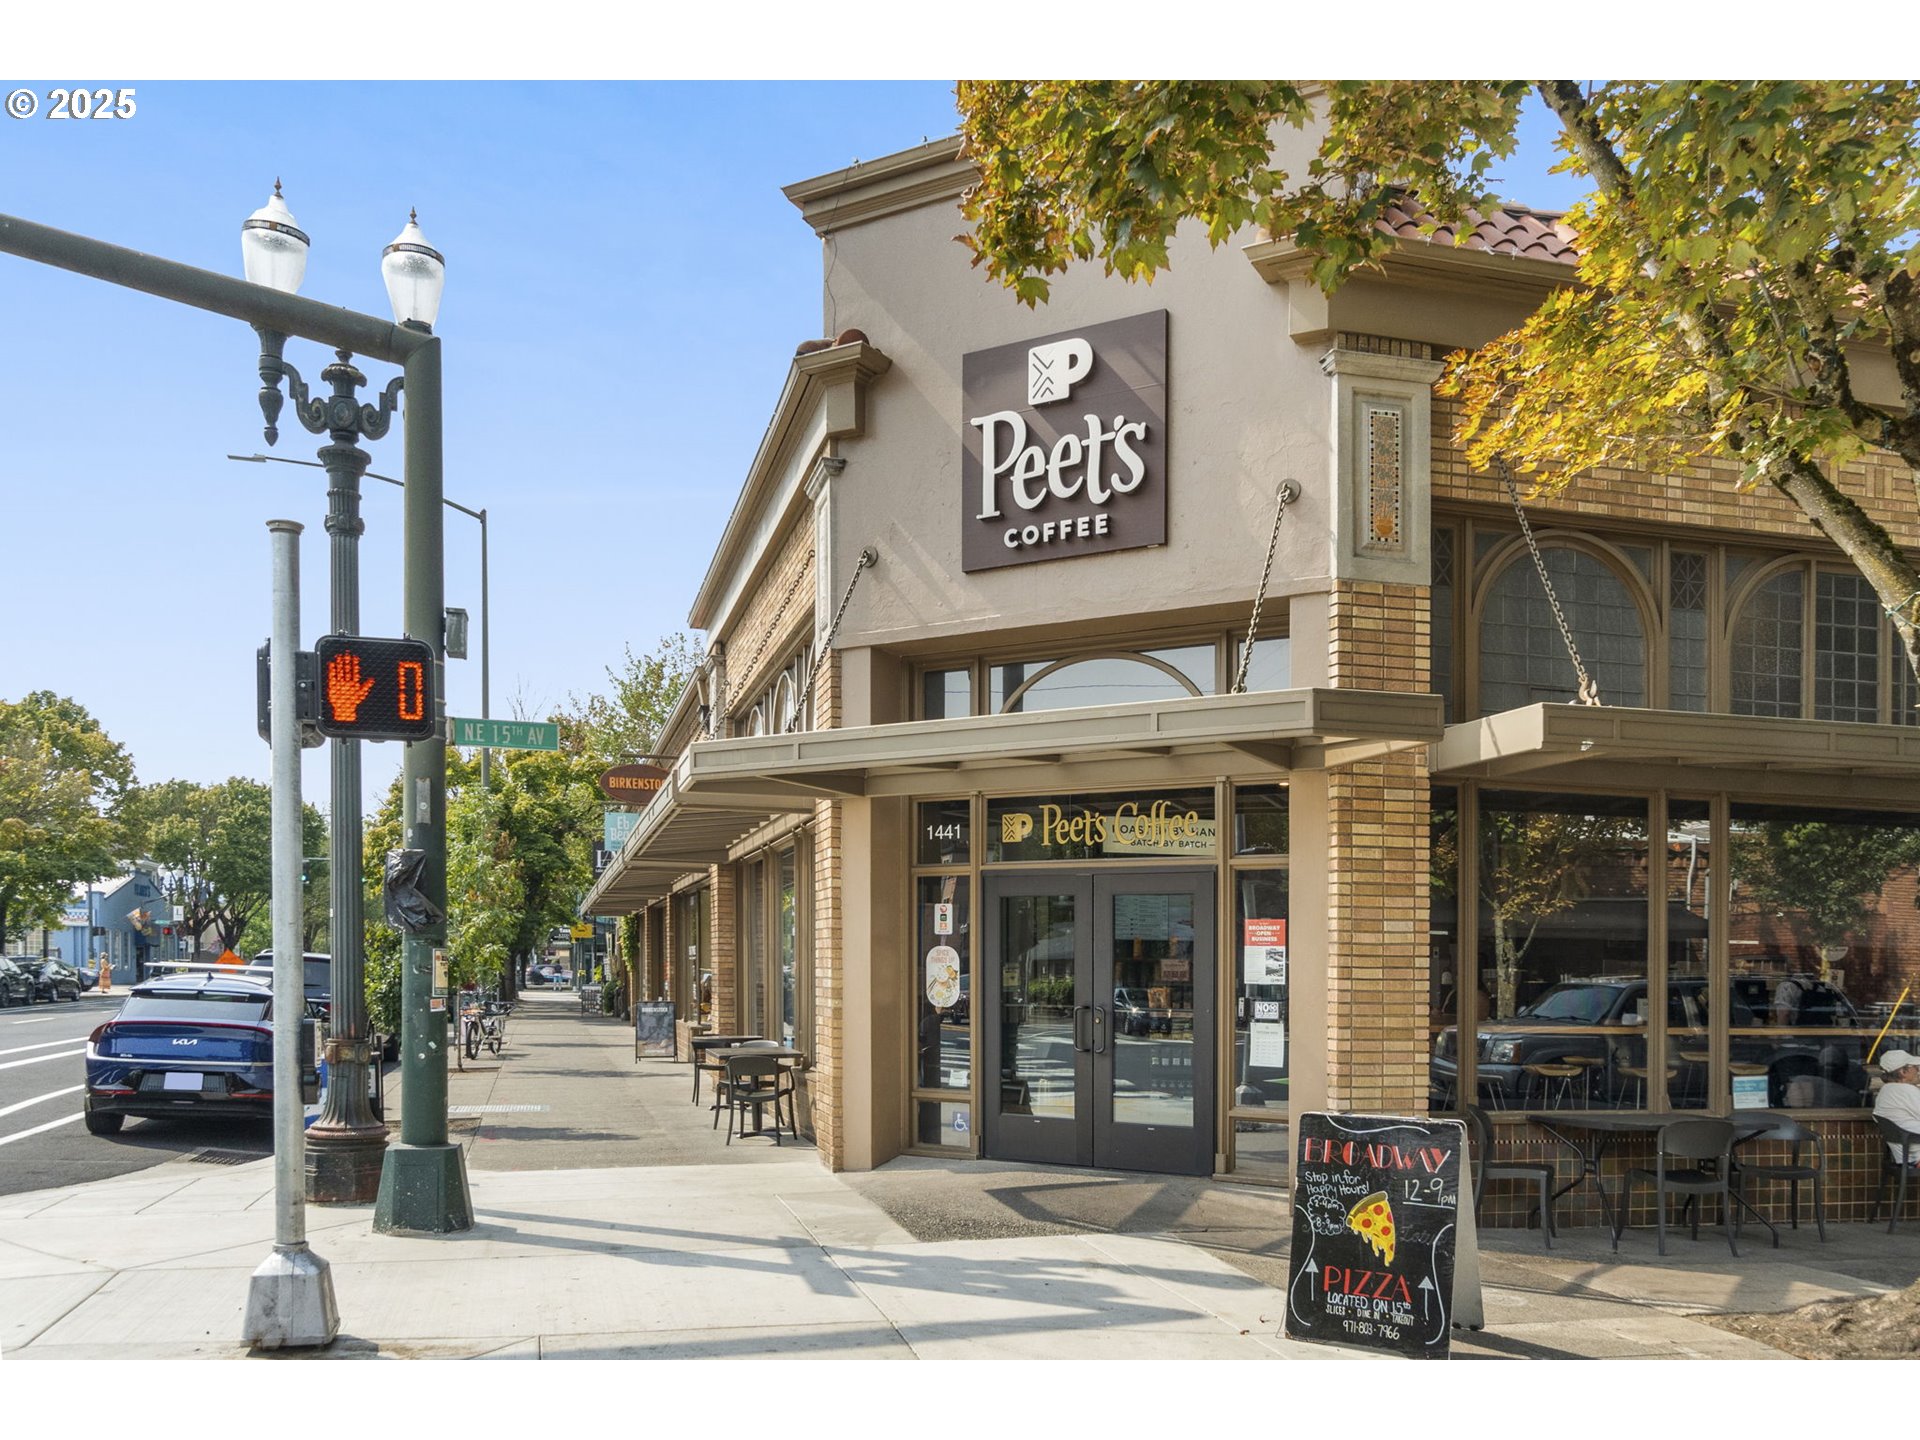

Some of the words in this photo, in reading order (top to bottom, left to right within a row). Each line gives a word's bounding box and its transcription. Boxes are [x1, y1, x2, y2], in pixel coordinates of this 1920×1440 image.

[970, 410, 1146, 519] Peet's
[1003, 513, 1108, 548] COFFEE
[398, 661, 422, 720] 0
[464, 723, 484, 742] NE
[493, 726, 523, 743] 15TH
[528, 729, 545, 745] AV
[926, 823, 962, 841] 1441
[1039, 803, 1107, 847] Peet's
[1114, 800, 1199, 847] Coffee
[1191, 828, 1215, 837] HAN
[1178, 841, 1207, 849] BATCH
[1304, 1137, 1451, 1174] BROADWAY
[1305, 1171, 1328, 1184] Stop
[1307, 1182, 1337, 1200] Happy
[1339, 1182, 1370, 1196] Hours!
[1324, 1265, 1413, 1304] PIZZA
[1325, 1304, 1346, 1316] SLICES
[1357, 1308, 1371, 1319] DINE
[1373, 1311, 1380, 1320] IN
[1327, 1291, 1368, 1309] LOCATED
[1373, 1299, 1388, 1313] ON
[1392, 1301, 1411, 1315] 15th
